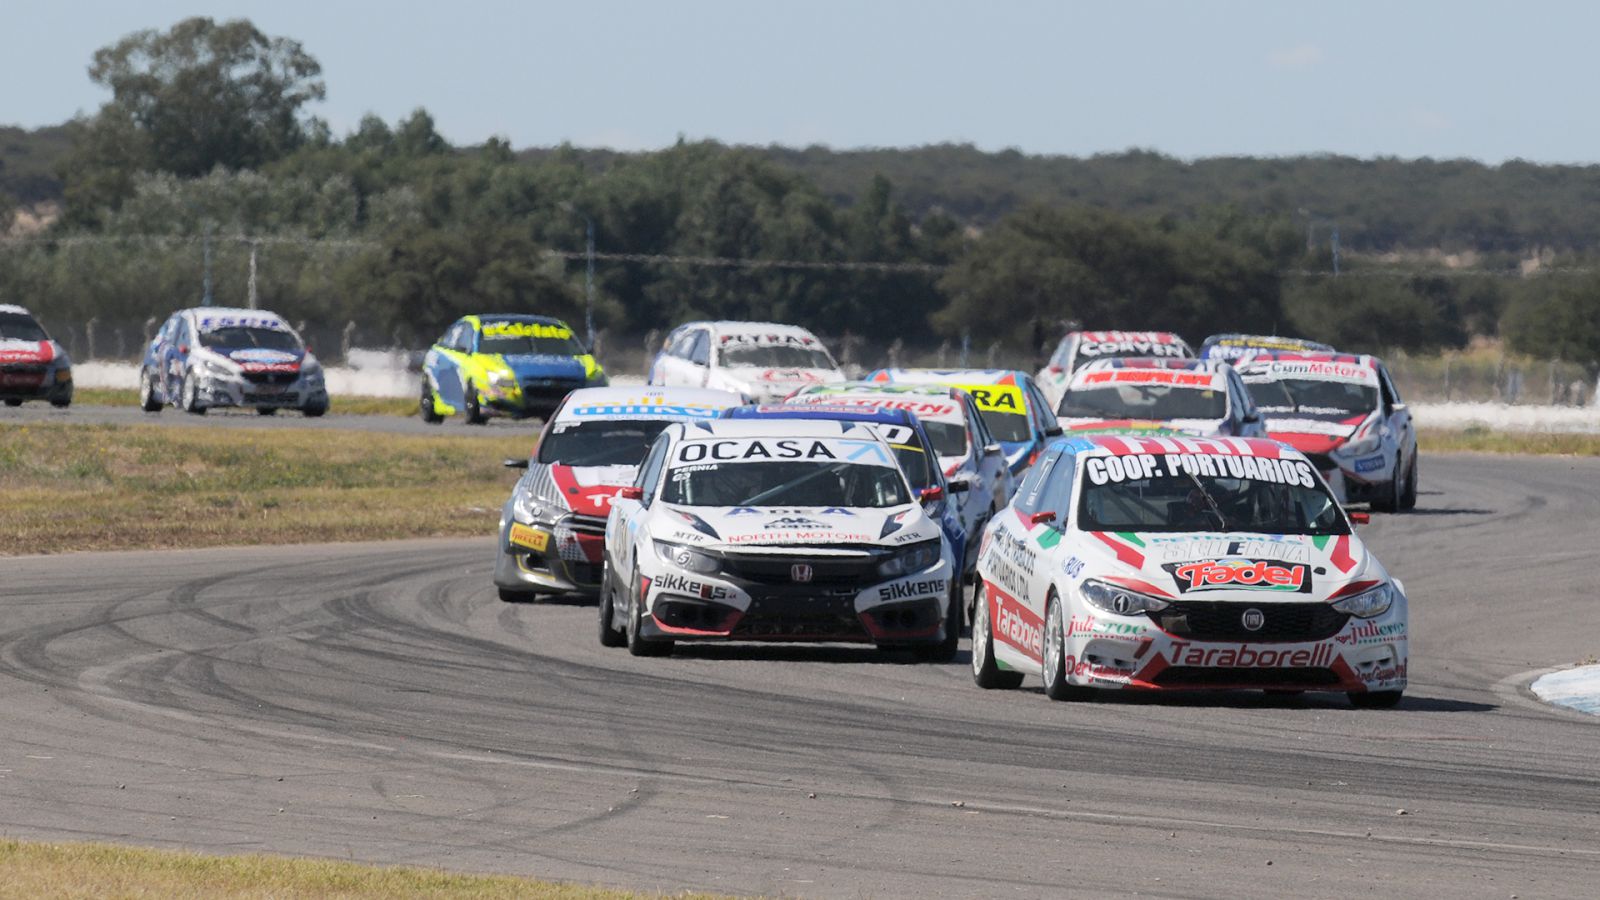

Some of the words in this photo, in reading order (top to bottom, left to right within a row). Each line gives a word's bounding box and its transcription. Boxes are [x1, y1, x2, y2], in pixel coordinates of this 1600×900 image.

[679, 440, 836, 463] OCASA
[1086, 457, 1163, 486] COOP.
[1164, 453, 1317, 489] PORTUARIOS
[673, 532, 704, 543] MTR
[728, 532, 790, 543] NORTH
[796, 531, 872, 541] MOTORS
[894, 532, 921, 542] MTR
[879, 579, 945, 601] sikkens
[1168, 640, 1334, 668] Taraborelli
